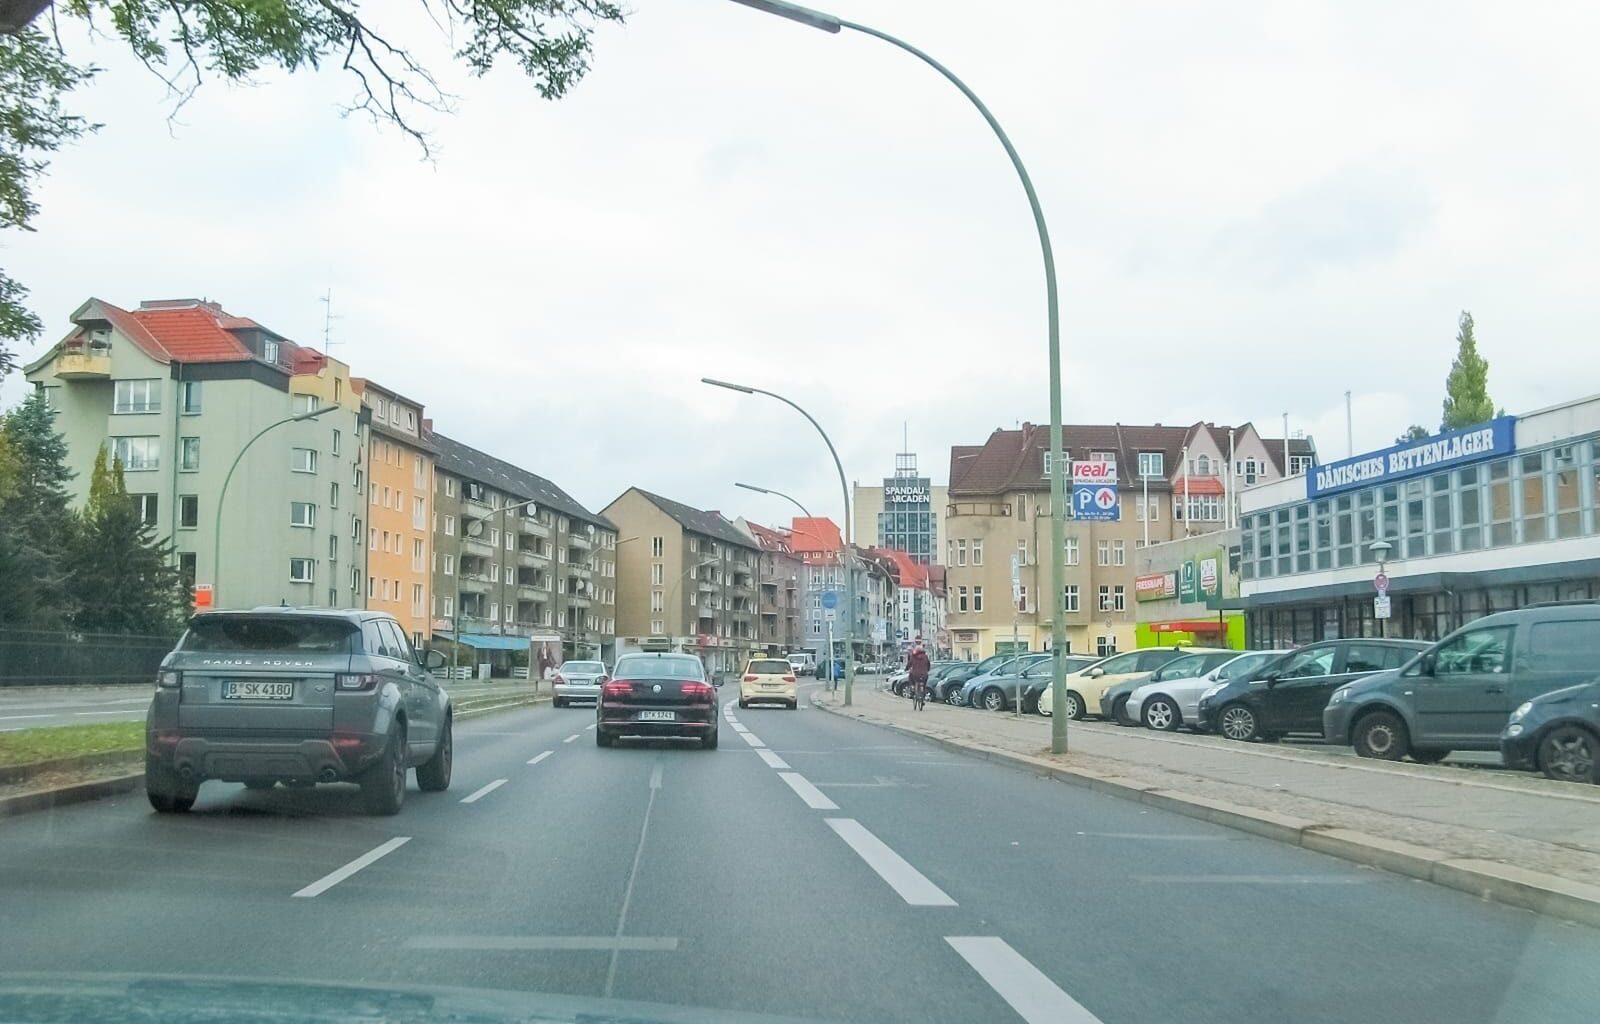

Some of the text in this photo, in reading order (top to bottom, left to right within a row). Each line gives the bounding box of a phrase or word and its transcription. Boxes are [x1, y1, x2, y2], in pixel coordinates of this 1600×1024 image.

[1316, 428, 1494, 490] DÄNISCHES BETTENLAGER
[885, 486, 930, 503] SPANDAU ARCADEN
[1080, 492, 1092, 509] P
[262, 684, 291, 695] 4180
